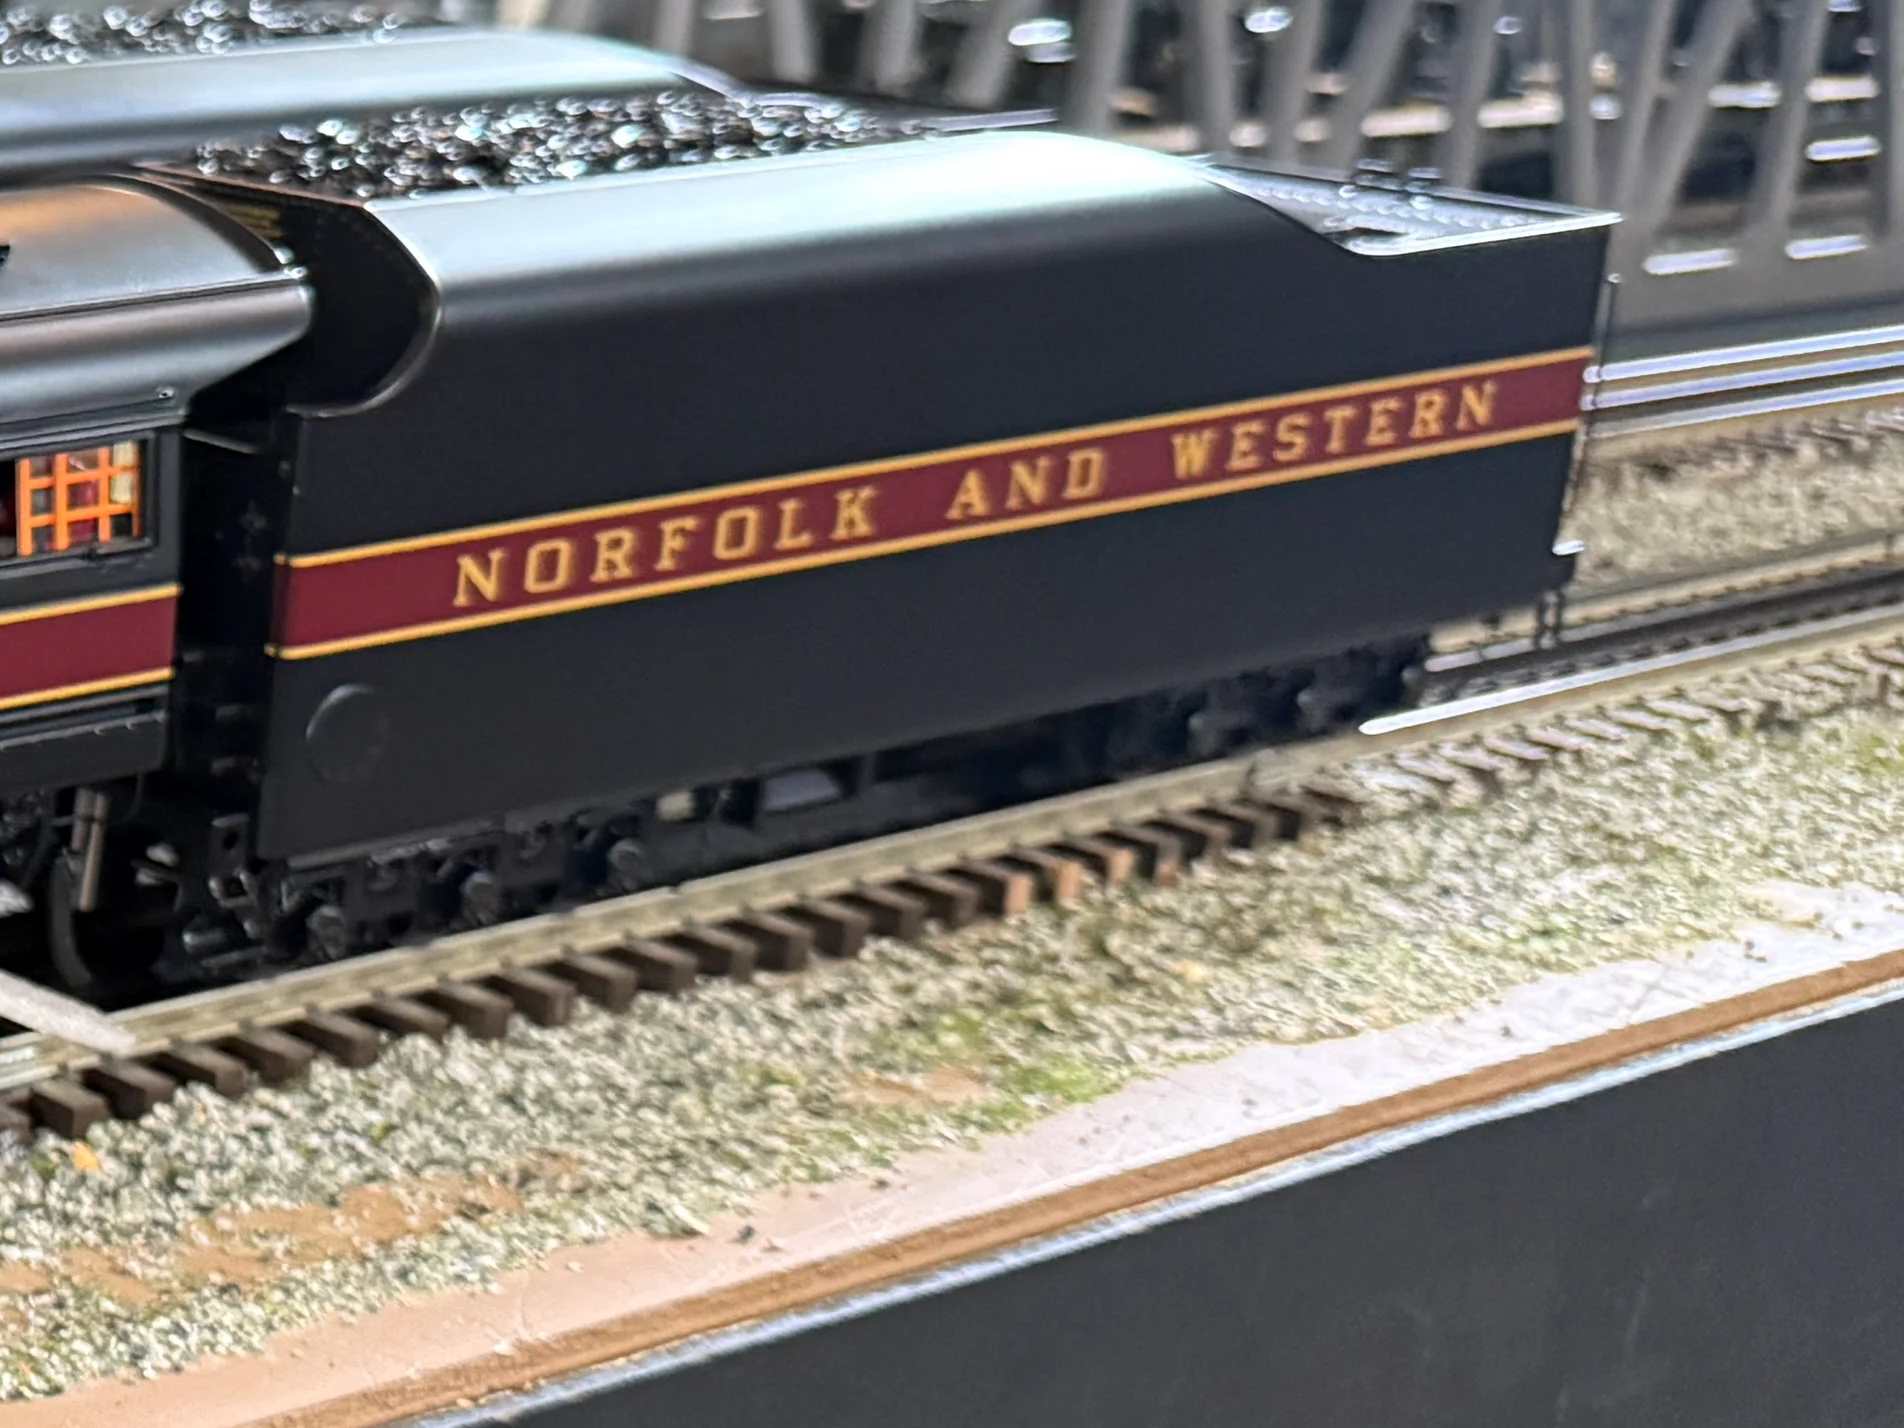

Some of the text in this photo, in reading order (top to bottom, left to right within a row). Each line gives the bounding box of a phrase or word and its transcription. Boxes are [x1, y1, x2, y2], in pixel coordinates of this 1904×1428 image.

[452, 380, 1499, 607] NORFOLK AND WESTERN
